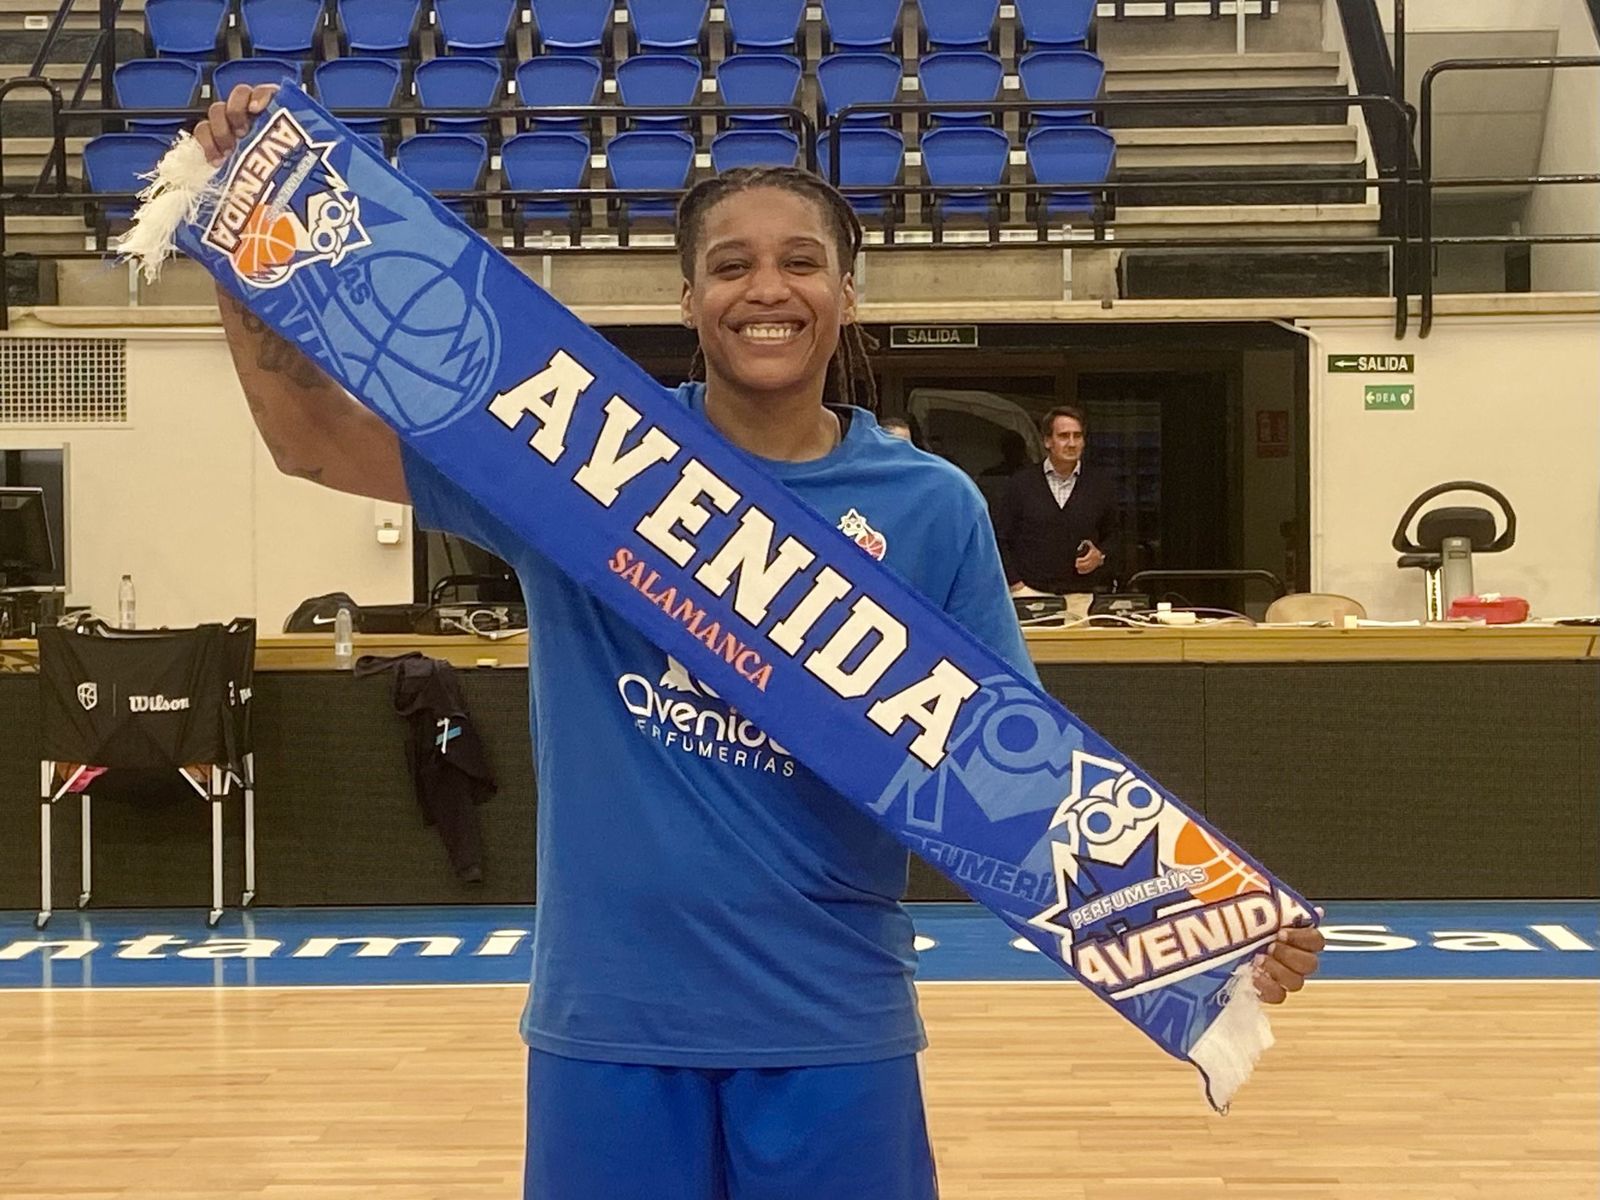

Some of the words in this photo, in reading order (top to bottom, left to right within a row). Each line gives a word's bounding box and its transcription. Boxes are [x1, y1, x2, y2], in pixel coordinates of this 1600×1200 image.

[210, 116, 303, 249] AVENIDA
[906, 329, 961, 343] SALIDA
[1357, 356, 1409, 371] SALIDA
[1375, 392, 1397, 403] DEA
[488, 348, 981, 770] AVENIDA
[607, 547, 774, 693] SALAMANCA
[128, 694, 190, 713] Wilson
[1068, 866, 1207, 930] PERFUMERÍAS
[1074, 888, 1313, 988] AVENIDA
